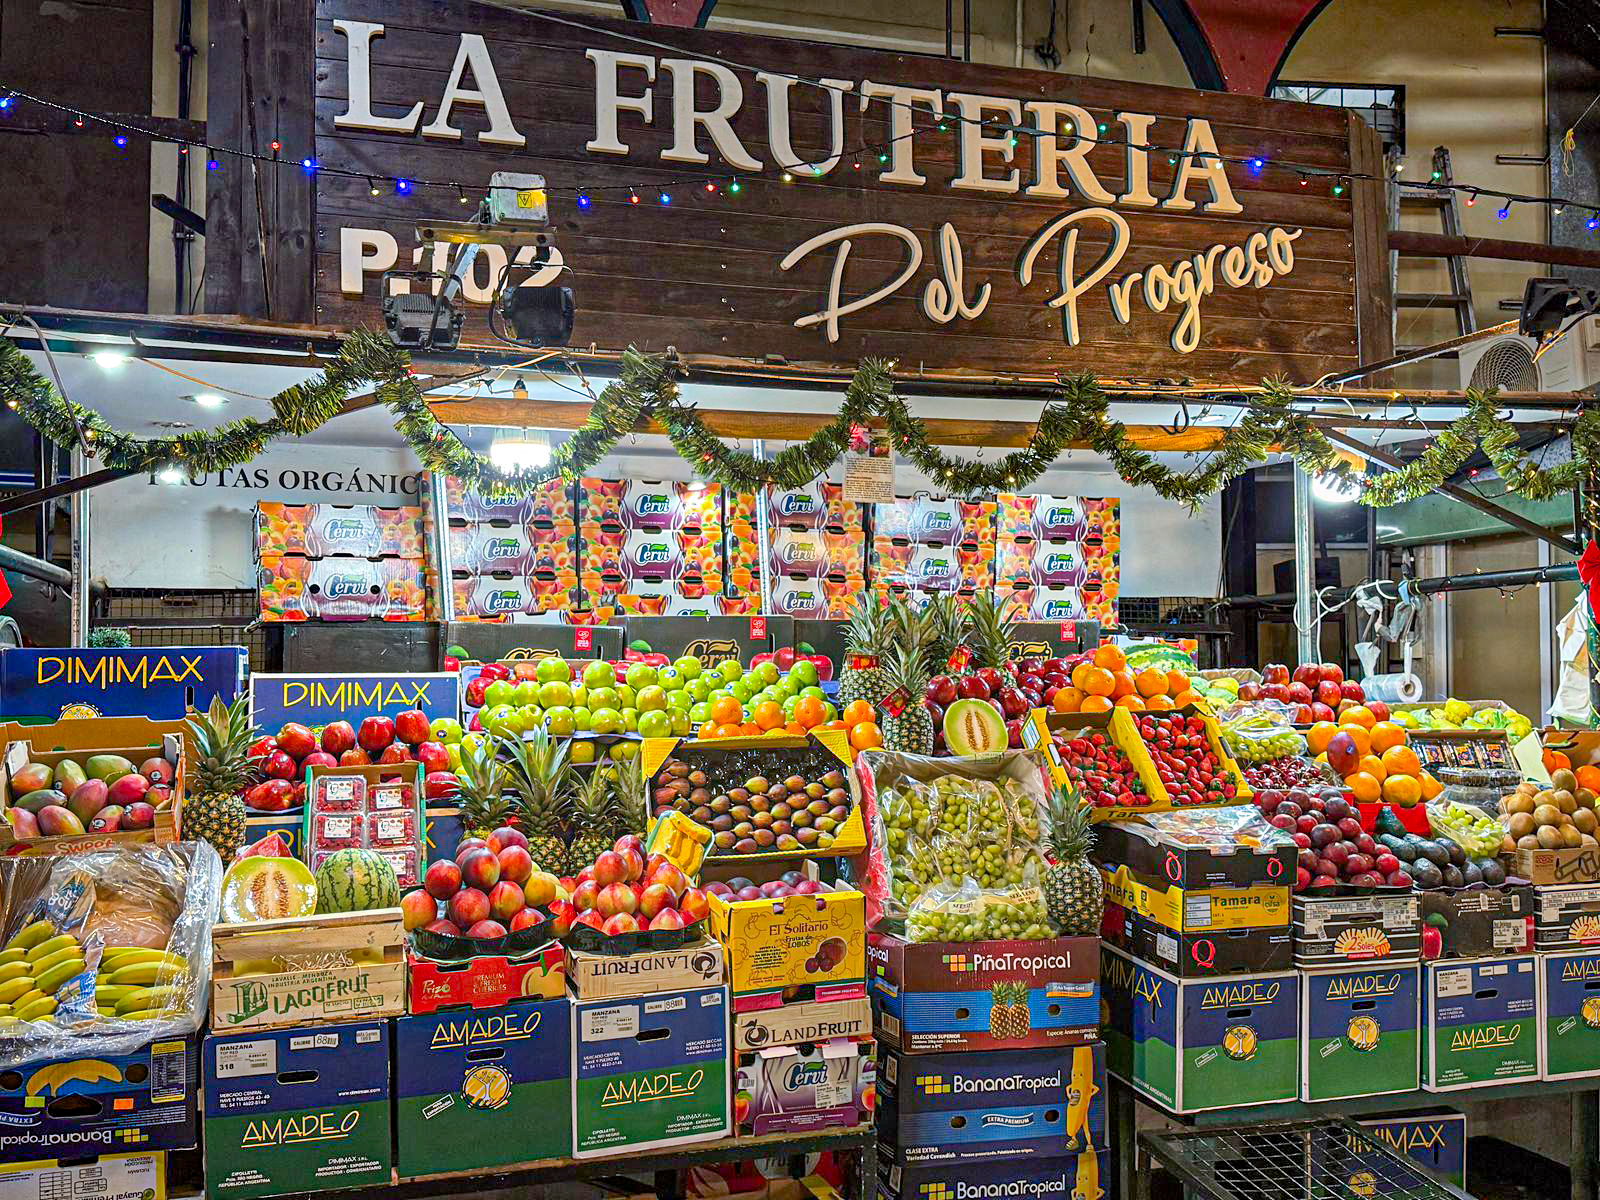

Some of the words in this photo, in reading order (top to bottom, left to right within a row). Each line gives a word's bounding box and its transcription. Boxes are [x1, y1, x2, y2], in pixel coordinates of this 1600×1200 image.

[333, 19, 526, 147] LA
[585, 48, 1244, 214] FRUTERIA
[1021, 207, 1303, 354] Progreso
[148, 466, 270, 489] UTAS
[634, 492, 671, 515] Cervi
[780, 493, 814, 516] Cervi
[1043, 507, 1075, 530] Cervi
[323, 519, 368, 543] Cervi
[482, 538, 521, 560] Cervi
[634, 542, 671, 565] Cervi
[781, 542, 816, 565] Cervi
[919, 558, 951, 580] Cervi
[1042, 551, 1074, 575] Cervi
[323, 573, 368, 600] Cervi
[483, 590, 522, 613] Cervi
[781, 590, 815, 613] Cervi
[37, 655, 204, 689] DIMIMAX
[283, 681, 432, 711] DIMIMAX
[1213, 894, 1261, 908] Tamara
[770, 925, 780, 936] El
[784, 922, 829, 935] Solitario
[1583, 924, 1589, 937] 2
[1349, 936, 1357, 950] 2
[591, 953, 690, 976] LANDFRUIT
[973, 951, 1072, 976] PiñaTropical
[302, 976, 337, 984] ARGENTINA
[1328, 974, 1401, 1000] AMADEO
[1202, 982, 1280, 1008] AMADEO
[591, 1009, 621, 1017] MANZANA
[432, 1012, 541, 1045] AMADEO
[771, 1020, 862, 1042] LANDFRUIT
[1451, 1024, 1521, 1049] AMADEO
[220, 1043, 253, 1052] MANZANA
[219, 1063, 235, 1071] 318
[783, 1060, 829, 1092] Cervi
[602, 1069, 704, 1103] AMADEO
[953, 1069, 1061, 1094] BananaTropical
[242, 1110, 360, 1145] AMADEO
[0, 1130, 113, 1150] BananaTropical
[957, 1174, 1066, 1200] BananaTropical
